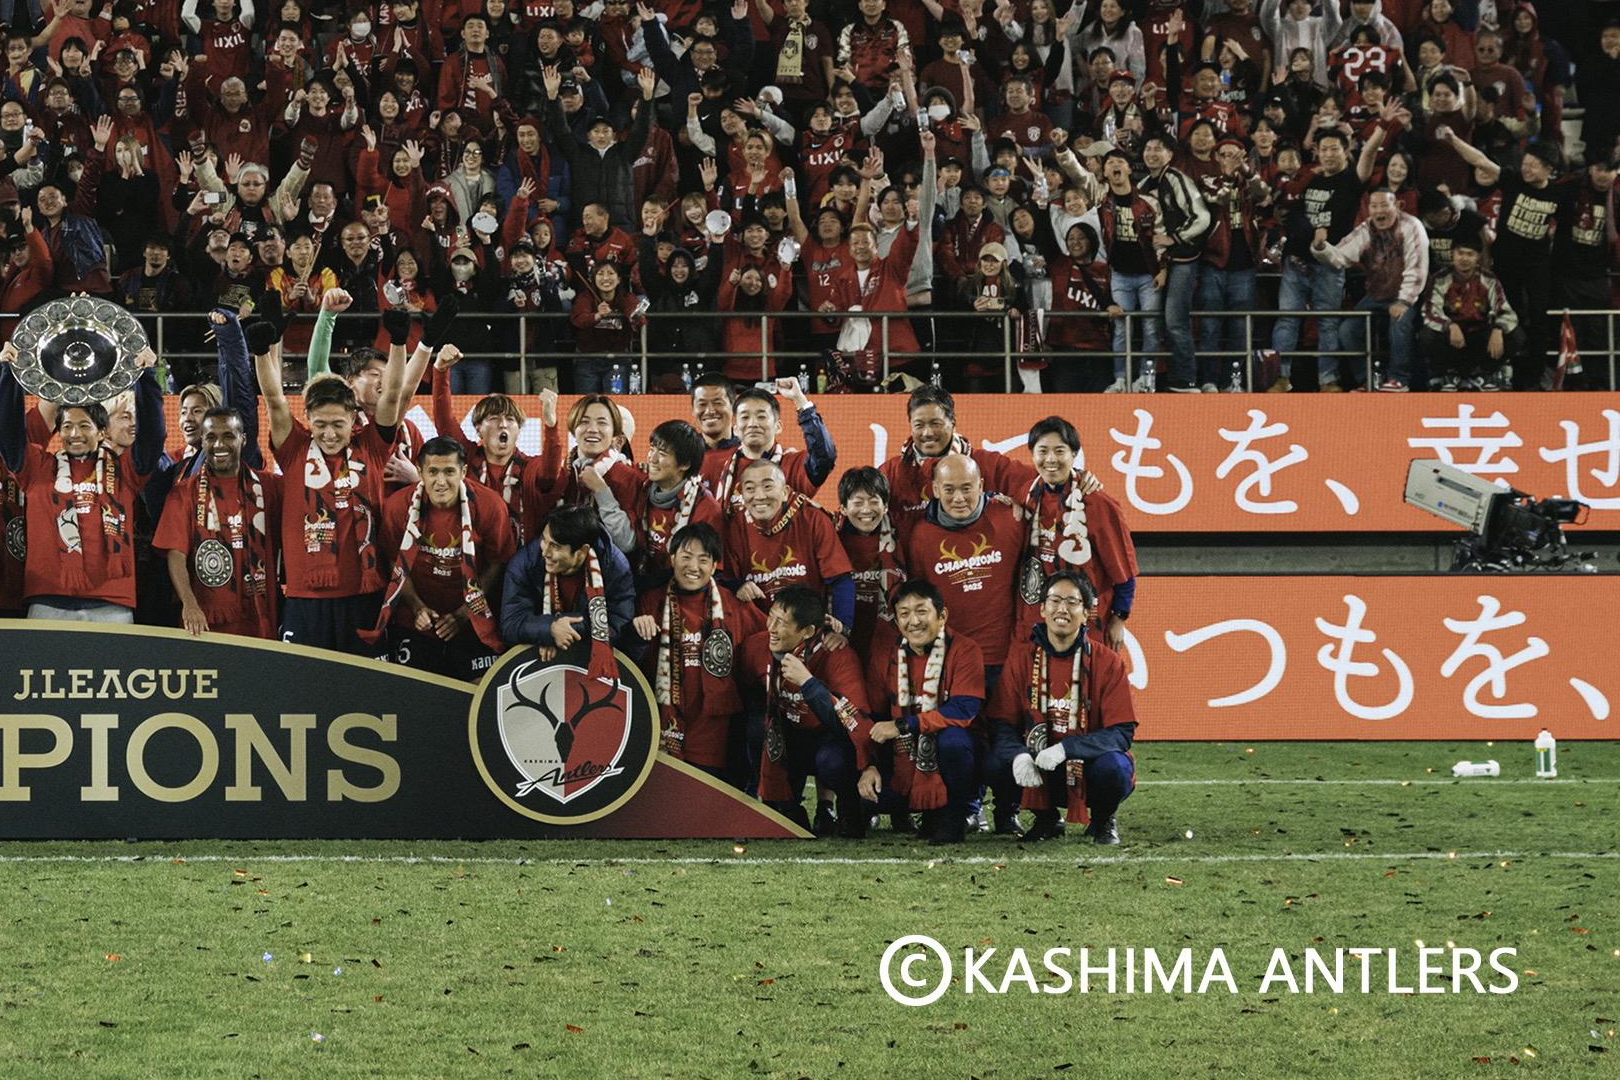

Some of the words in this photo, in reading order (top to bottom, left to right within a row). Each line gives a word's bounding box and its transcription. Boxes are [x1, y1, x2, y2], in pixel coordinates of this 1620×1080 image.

[526, 5, 555, 18] LIXI
[213, 34, 245, 49] LIXIL
[1343, 45, 1387, 80] 23
[817, 273, 831, 287] 12
[982, 285, 998, 298] 40
[1067, 286, 1097, 309] LIXI
[8, 479, 16, 502] 2025
[197, 506, 205, 526] 2025
[433, 568, 451, 577] 2025
[934, 550, 1002, 574] CHAMPIONS
[746, 564, 806, 582] CHAMPIONS
[964, 583, 983, 592] 2025
[398, 638, 411, 665] 5
[15, 668, 219, 699] J.LEAGUE
[1031, 684, 1039, 709] 2025
[517, 761, 624, 796] Antlers
